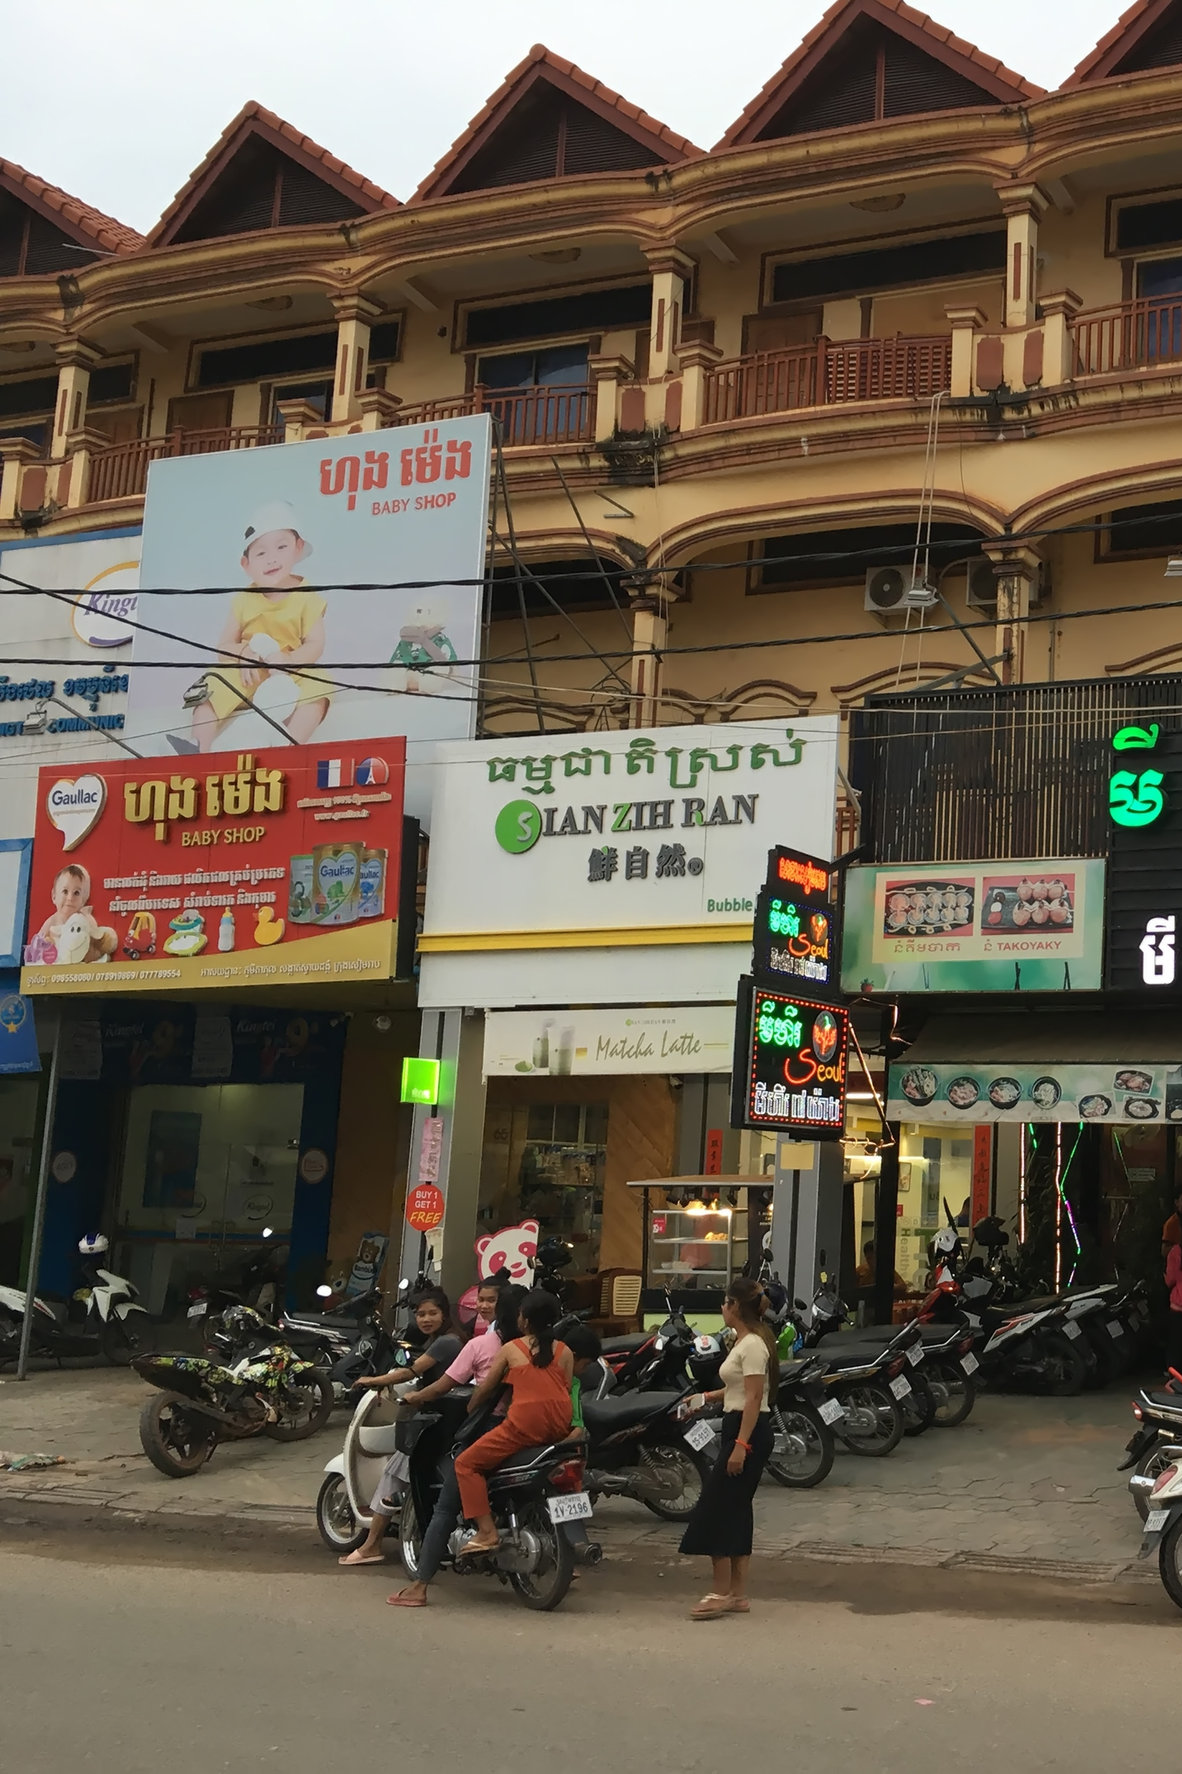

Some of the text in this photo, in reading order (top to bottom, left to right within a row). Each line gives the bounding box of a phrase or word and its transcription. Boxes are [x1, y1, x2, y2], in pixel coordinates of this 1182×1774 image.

[320, 450, 390, 511] ហុង
[372, 492, 457, 516] BABY SHOP
[51, 788, 98, 806] Gaullac
[124, 775, 198, 841] ហុង
[181, 826, 266, 847] BABY SHOP
[320, 864, 355, 878] Gaullac
[707, 898, 753, 913] Bubble
[997, 941, 1063, 951] TAKOYAKY
[596, 1029, 702, 1061] Matcha Latte
[784, 1048, 845, 1084] Seoul
[415, 1190, 439, 1199] BUY 1
[414, 1200, 432, 1209] GET
[410, 1211, 442, 1224] FREE
